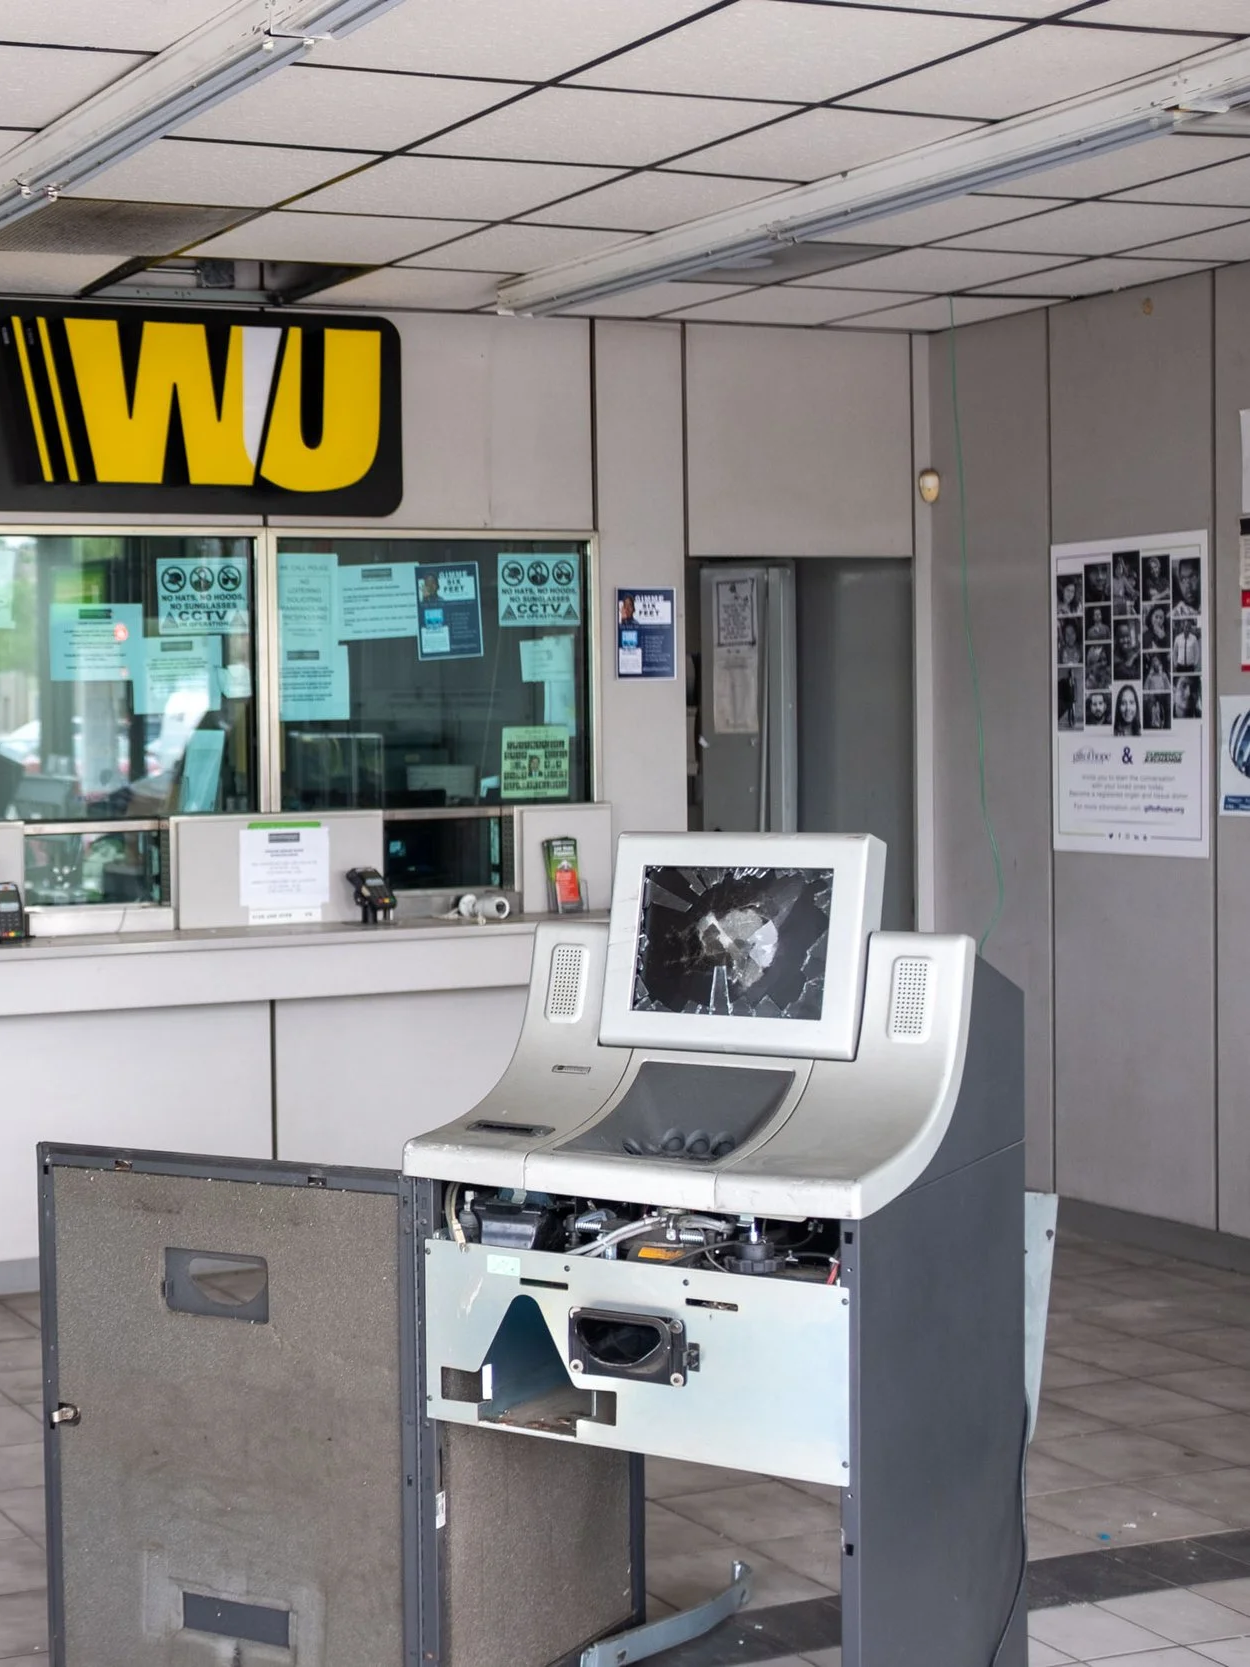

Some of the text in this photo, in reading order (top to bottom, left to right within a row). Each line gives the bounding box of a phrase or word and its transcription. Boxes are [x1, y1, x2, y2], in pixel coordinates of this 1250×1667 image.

[63, 317, 381, 492] WU
[184, 602, 237, 610] SUNGLASSES
[516, 603, 561, 613] CCTV
[178, 610, 227, 620] CCTV
[1122, 746, 1133, 765] &
